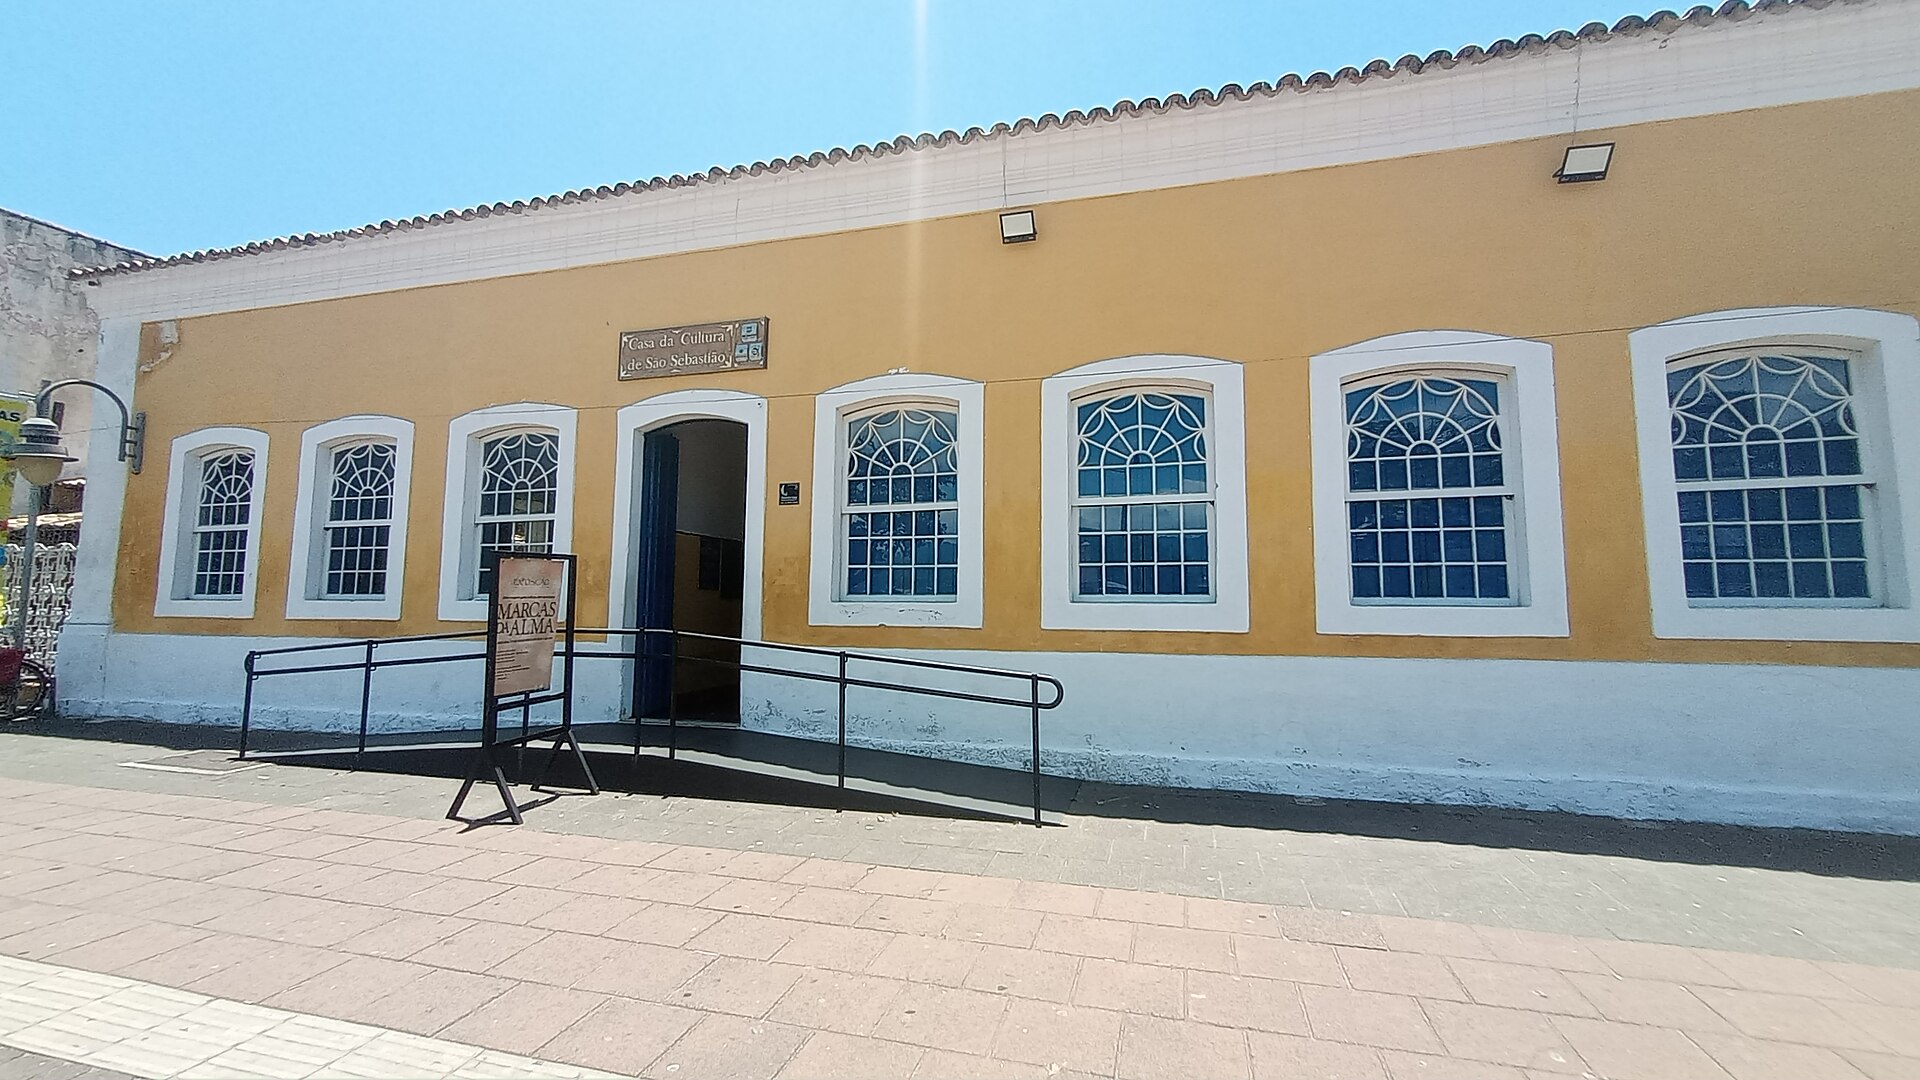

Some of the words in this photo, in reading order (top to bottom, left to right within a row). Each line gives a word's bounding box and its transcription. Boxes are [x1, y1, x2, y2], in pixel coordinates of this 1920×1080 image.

[628, 338, 655, 351] Casa
[659, 335, 674, 348] da
[681, 331, 725, 345] Cultura
[628, 358, 642, 371] de
[645, 355, 667, 370] São
[670, 352, 725, 367] Sebastião
[497, 601, 557, 620] MARCAS
[496, 621, 509, 634] DA
[508, 618, 554, 636] ALMA
